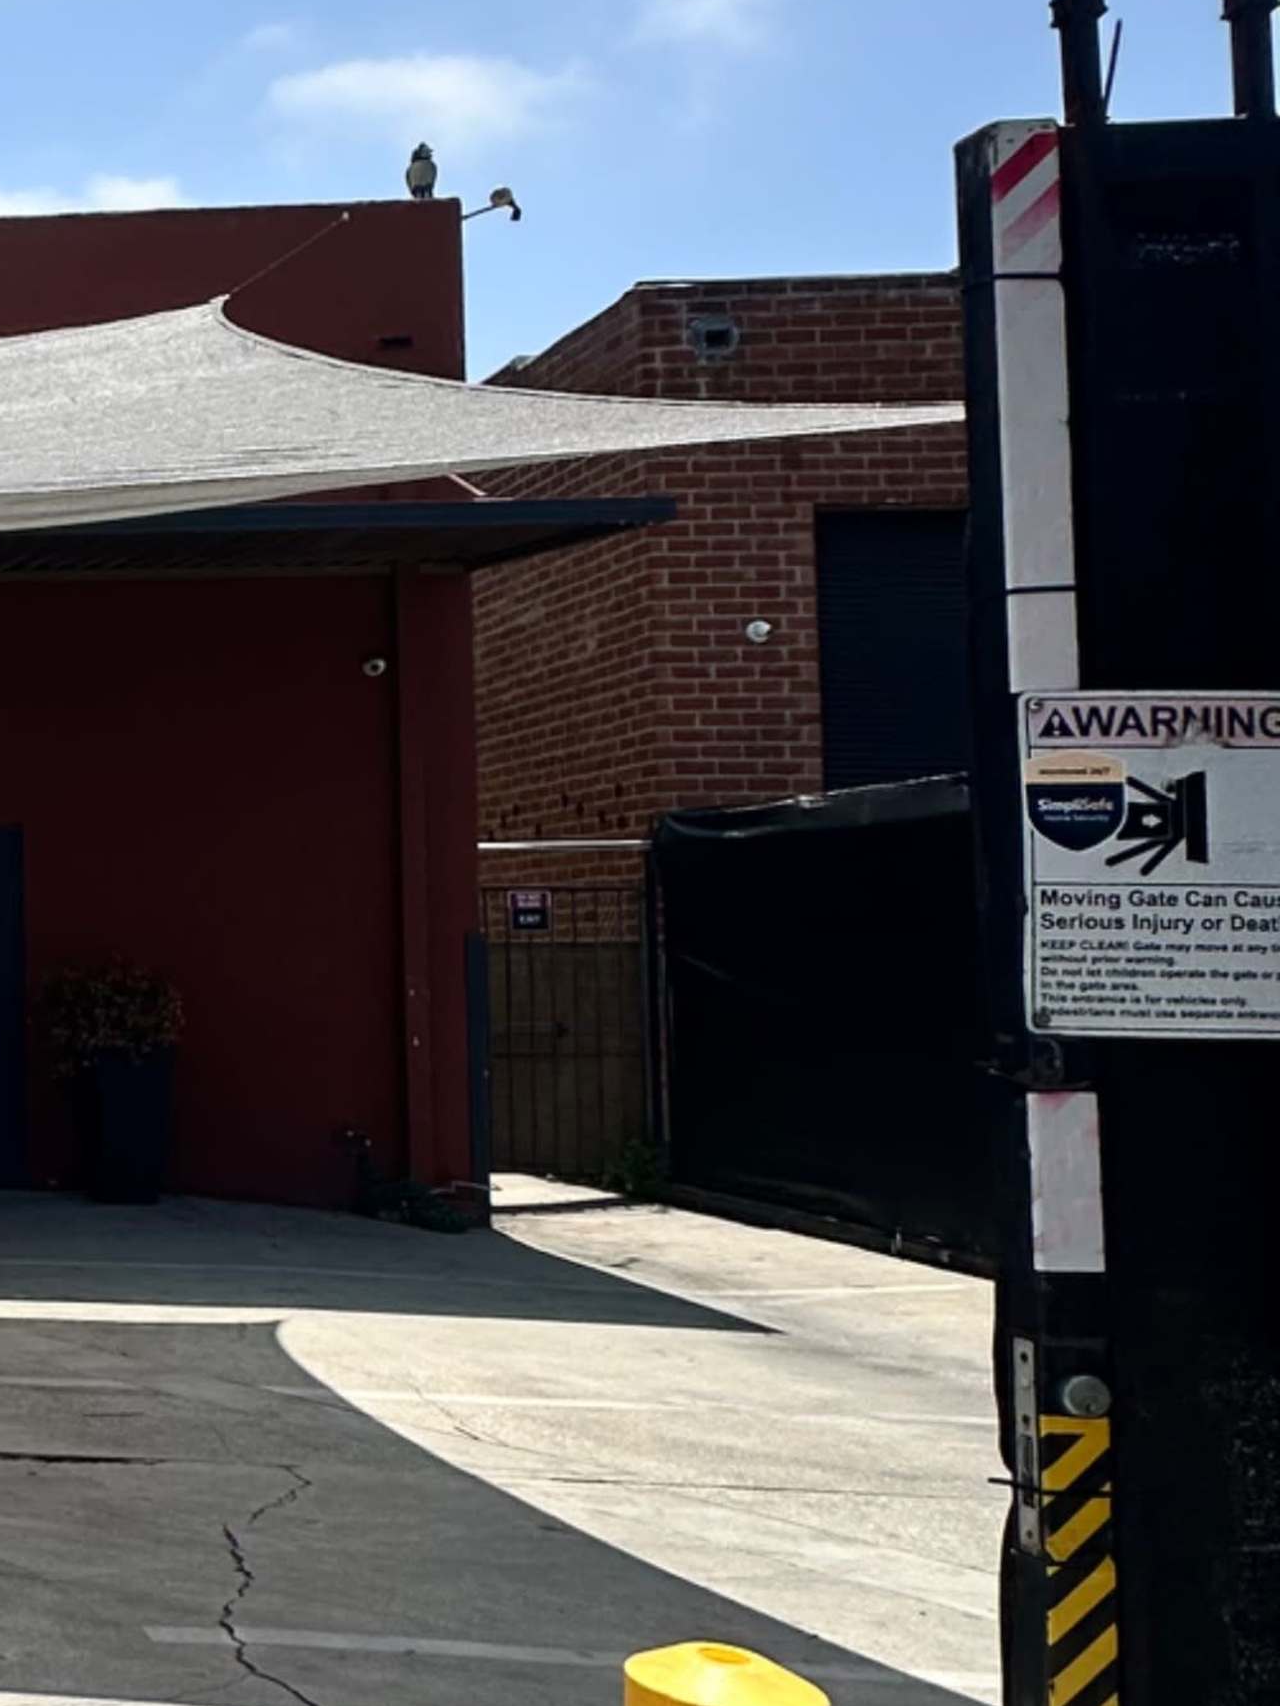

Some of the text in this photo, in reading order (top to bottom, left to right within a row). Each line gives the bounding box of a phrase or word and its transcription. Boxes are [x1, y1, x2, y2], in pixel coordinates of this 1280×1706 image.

[1072, 705, 1280, 739] WARNING
[1040, 889, 1121, 911] Moving
[1127, 890, 1179, 908] Gate
[1185, 890, 1228, 908] Can
[1040, 912, 1280, 935] Serious Injury or Deat
[1040, 939, 1075, 950] KEEP
